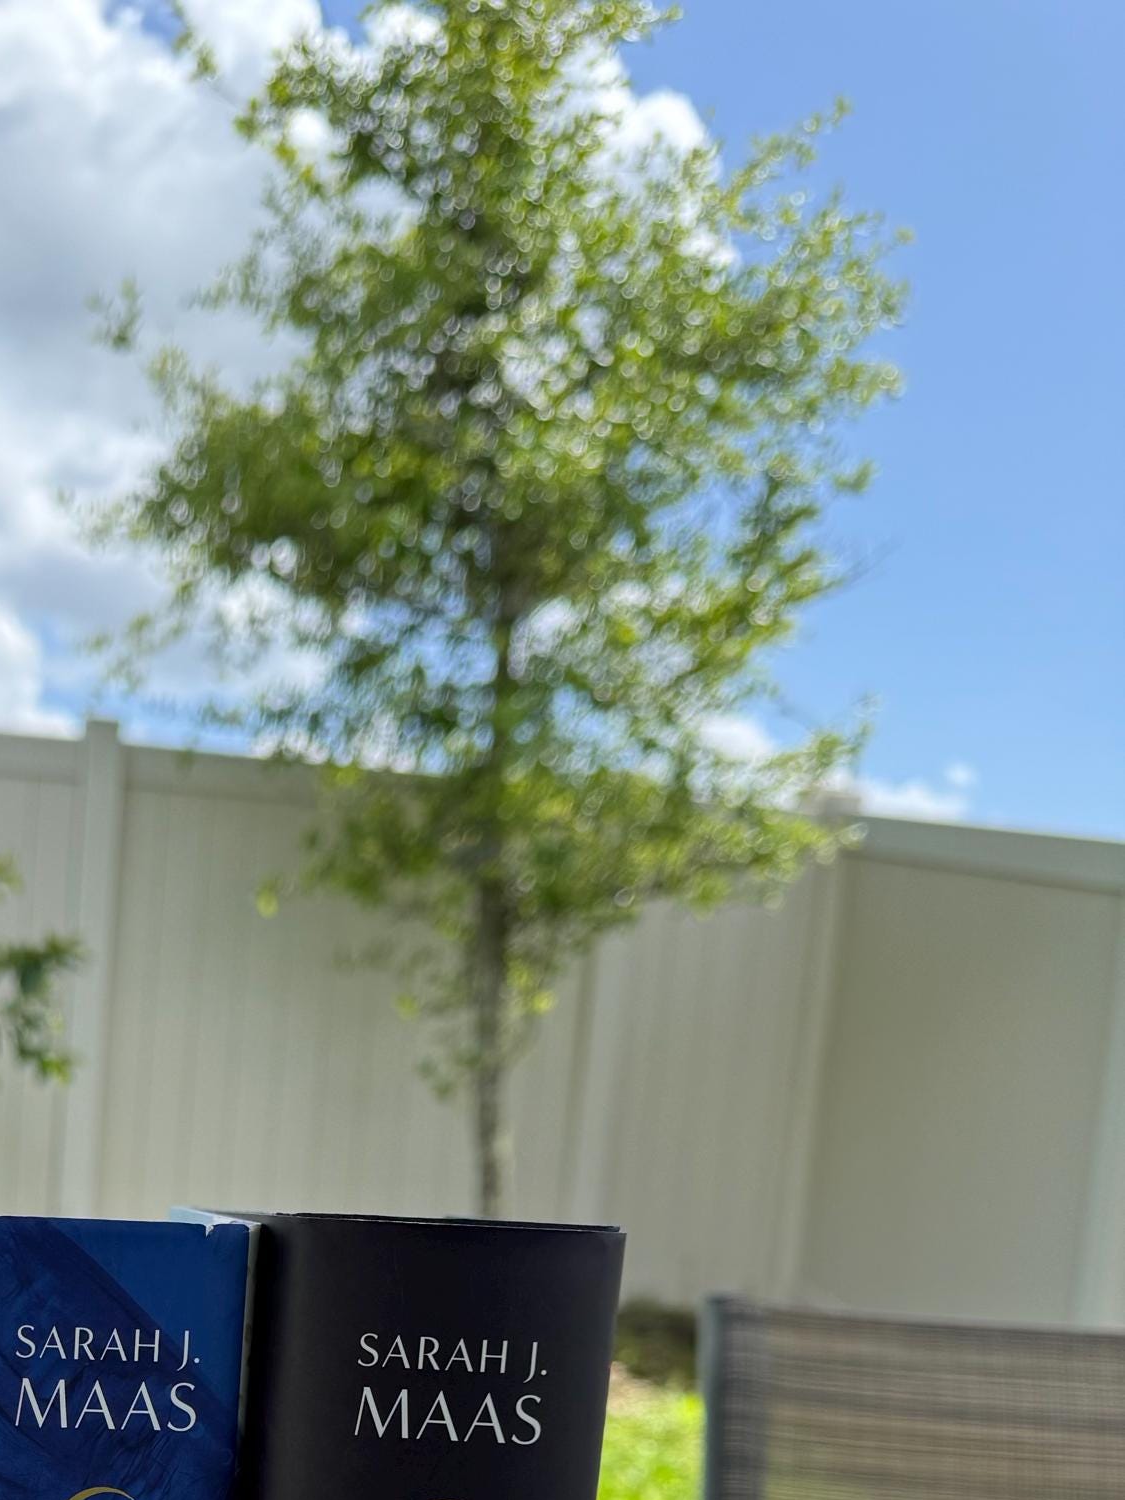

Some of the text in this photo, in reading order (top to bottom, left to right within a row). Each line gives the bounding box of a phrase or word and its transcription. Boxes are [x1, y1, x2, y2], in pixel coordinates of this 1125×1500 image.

[15, 1324, 200, 1372] SARAH J.
[357, 1332, 548, 1384] SARAH J.
[14, 1377, 197, 1432] MAAS
[354, 1386, 542, 1445] MAAS
